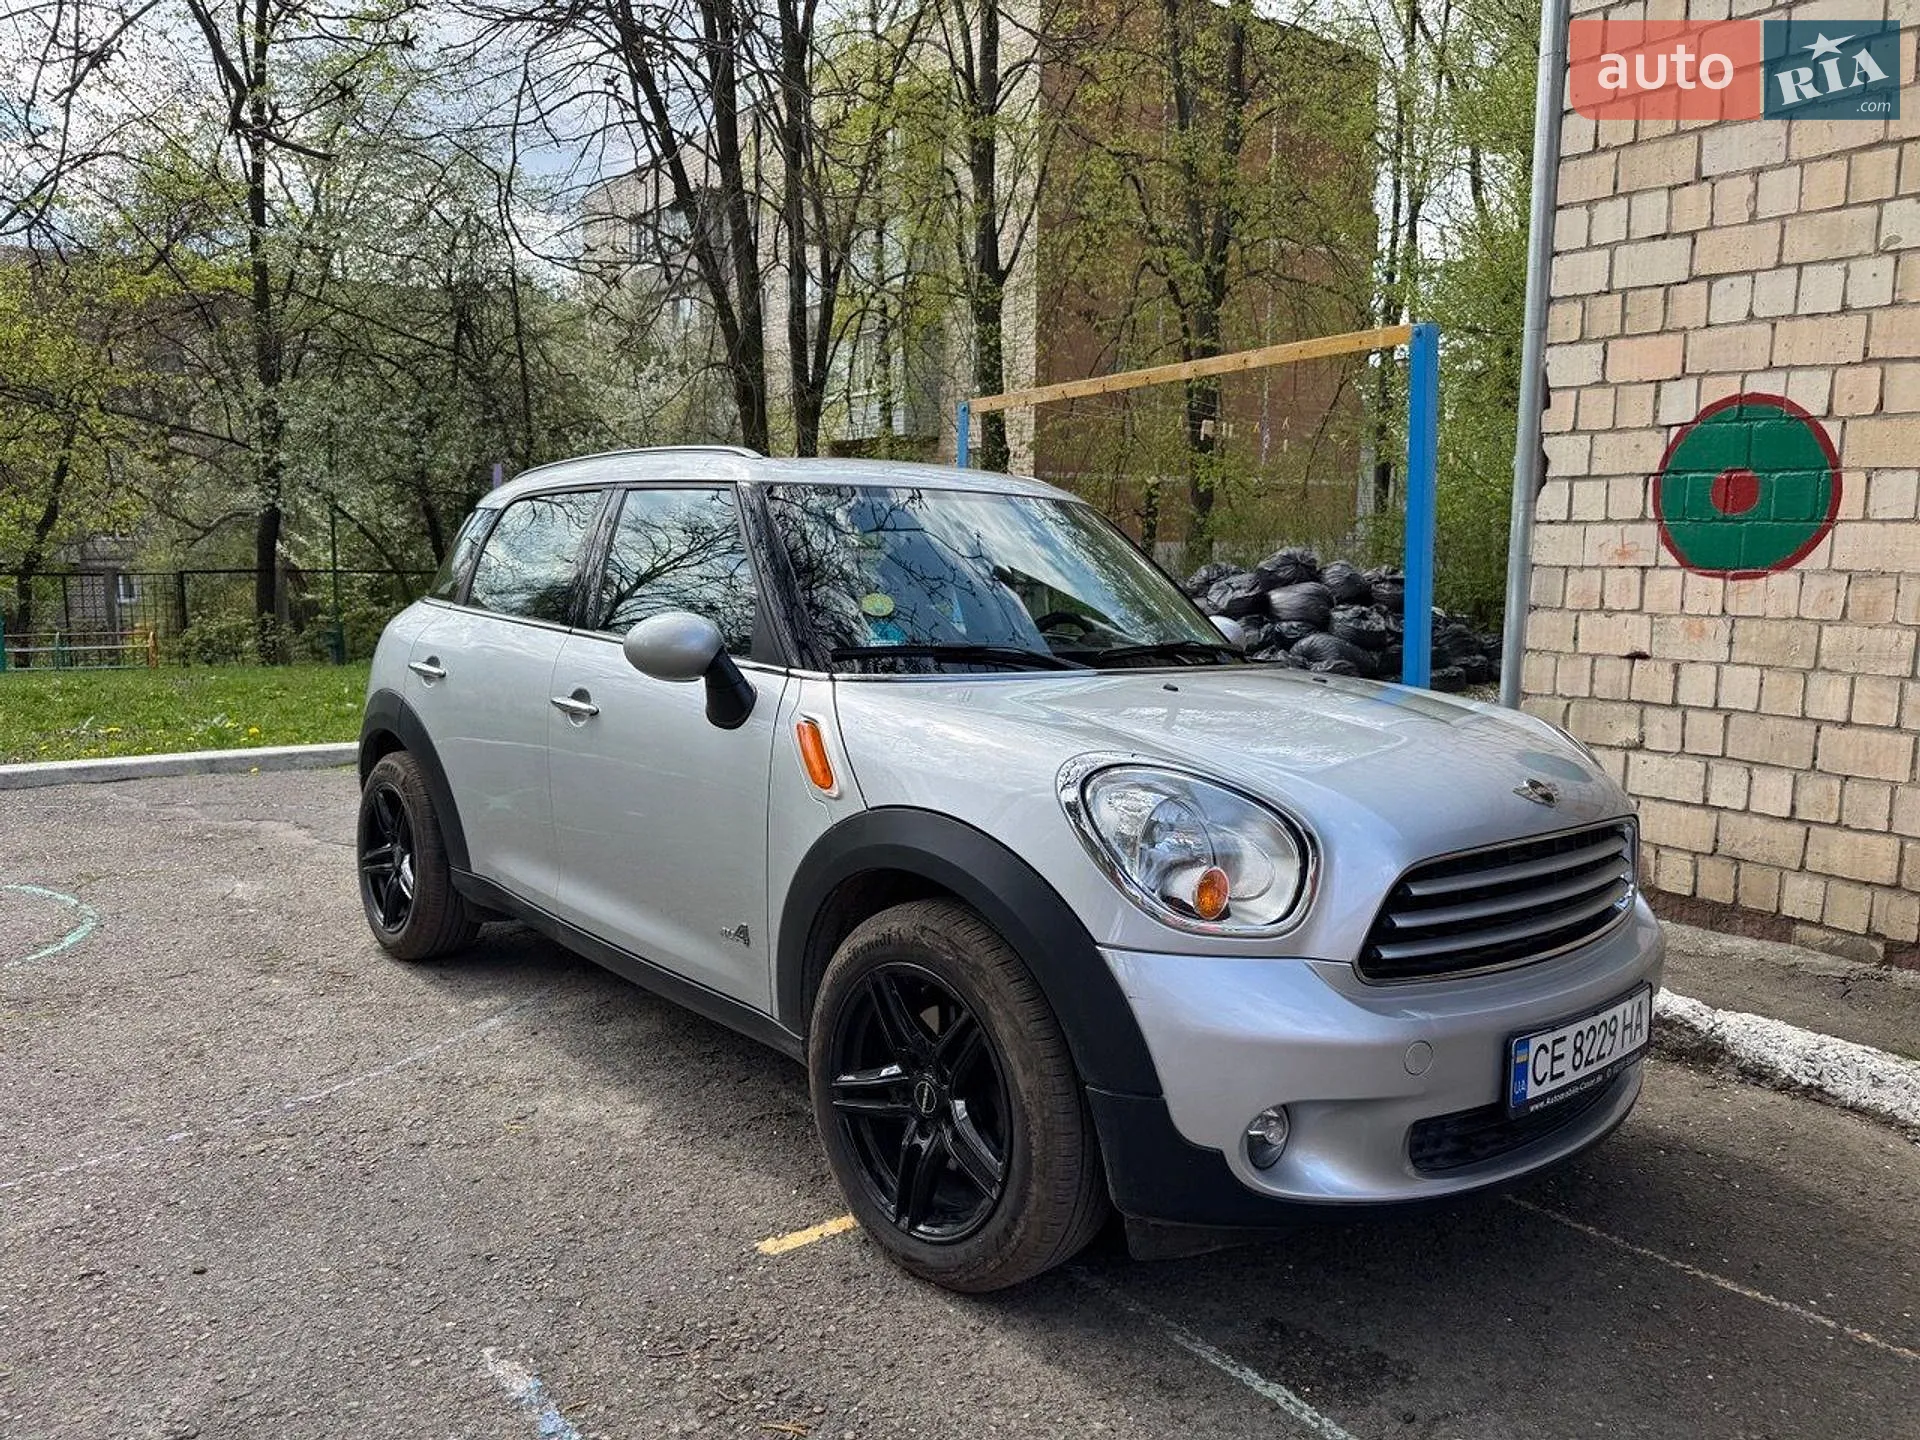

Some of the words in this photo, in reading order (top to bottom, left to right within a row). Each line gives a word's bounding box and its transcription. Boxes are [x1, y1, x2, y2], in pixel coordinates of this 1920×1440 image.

[1532, 1035, 1567, 1087] CE
[1571, 1015, 1618, 1072] 8229
[1622, 1001, 1644, 1049] HA
[1513, 1079, 1527, 1095] UA
